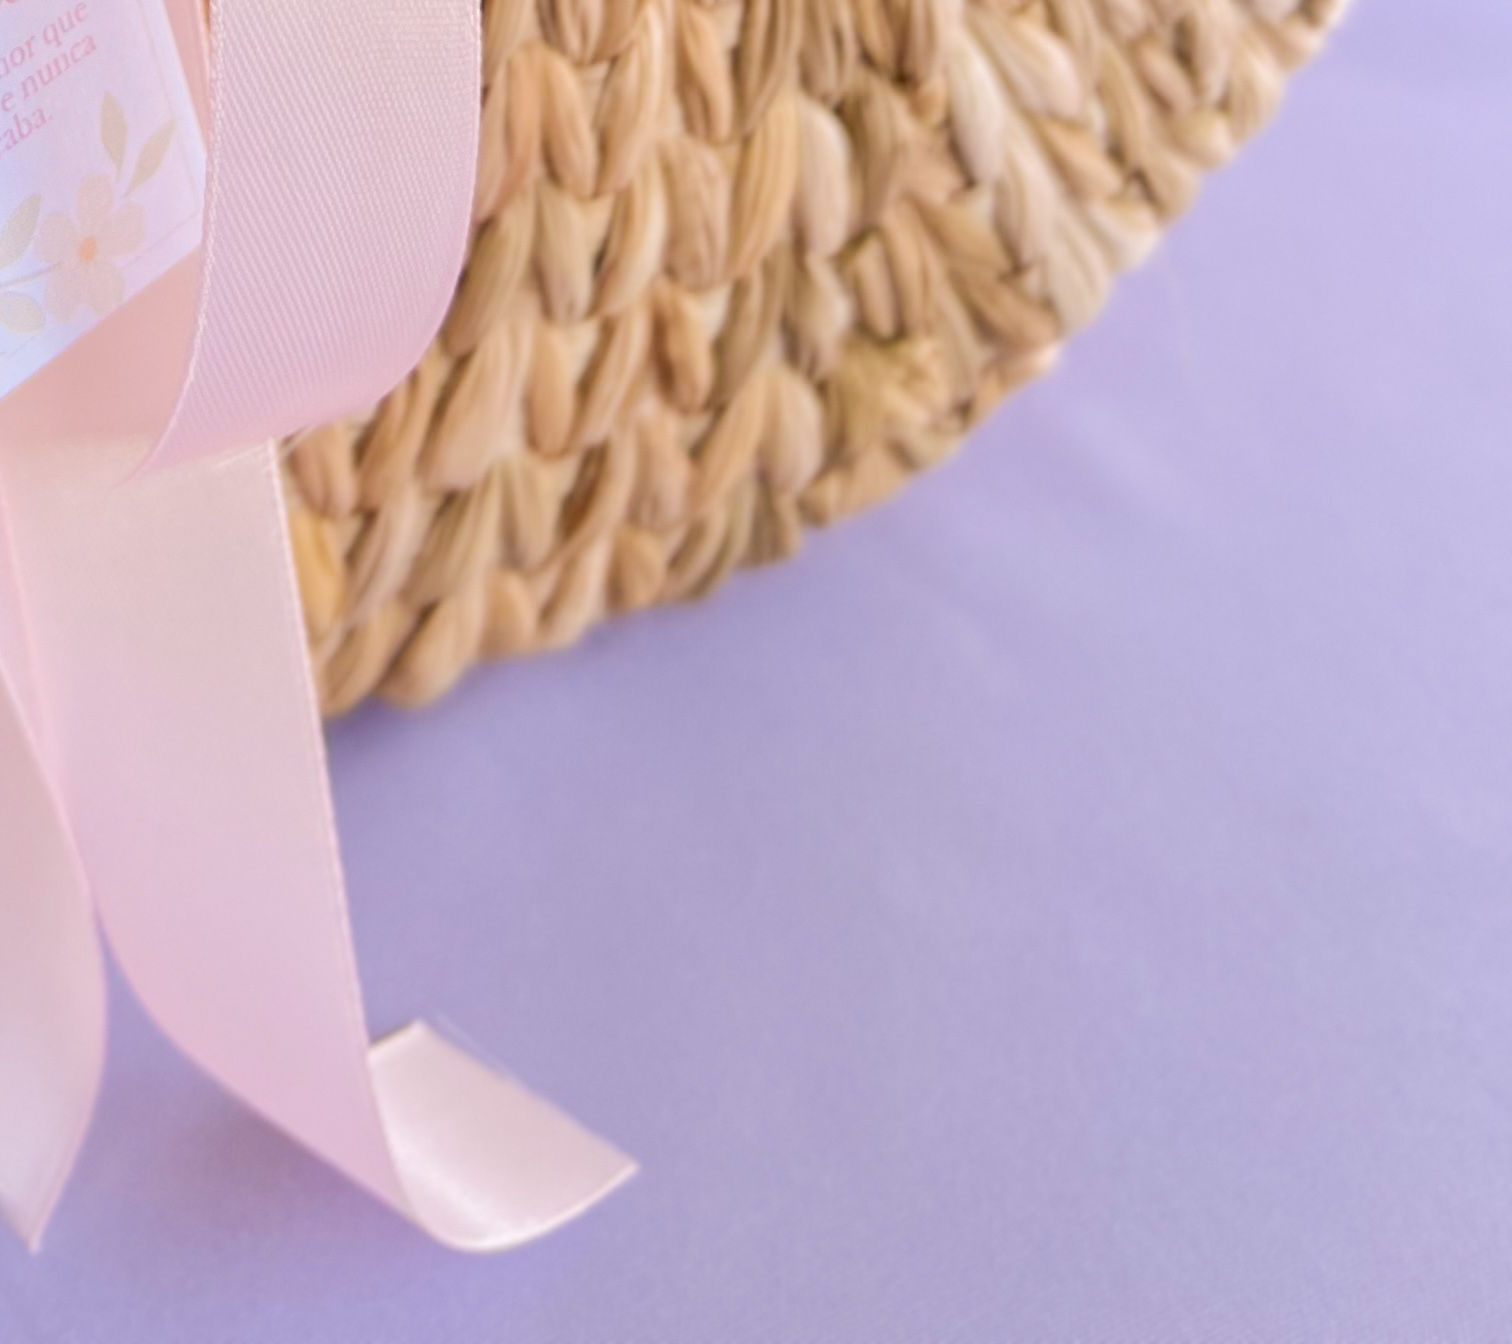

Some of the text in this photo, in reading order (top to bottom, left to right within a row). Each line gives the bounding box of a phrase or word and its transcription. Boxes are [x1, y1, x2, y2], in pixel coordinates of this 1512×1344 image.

[41, 0, 90, 45] que
[0, 90, 15, 114] e
[21, 32, 100, 96] nunca
